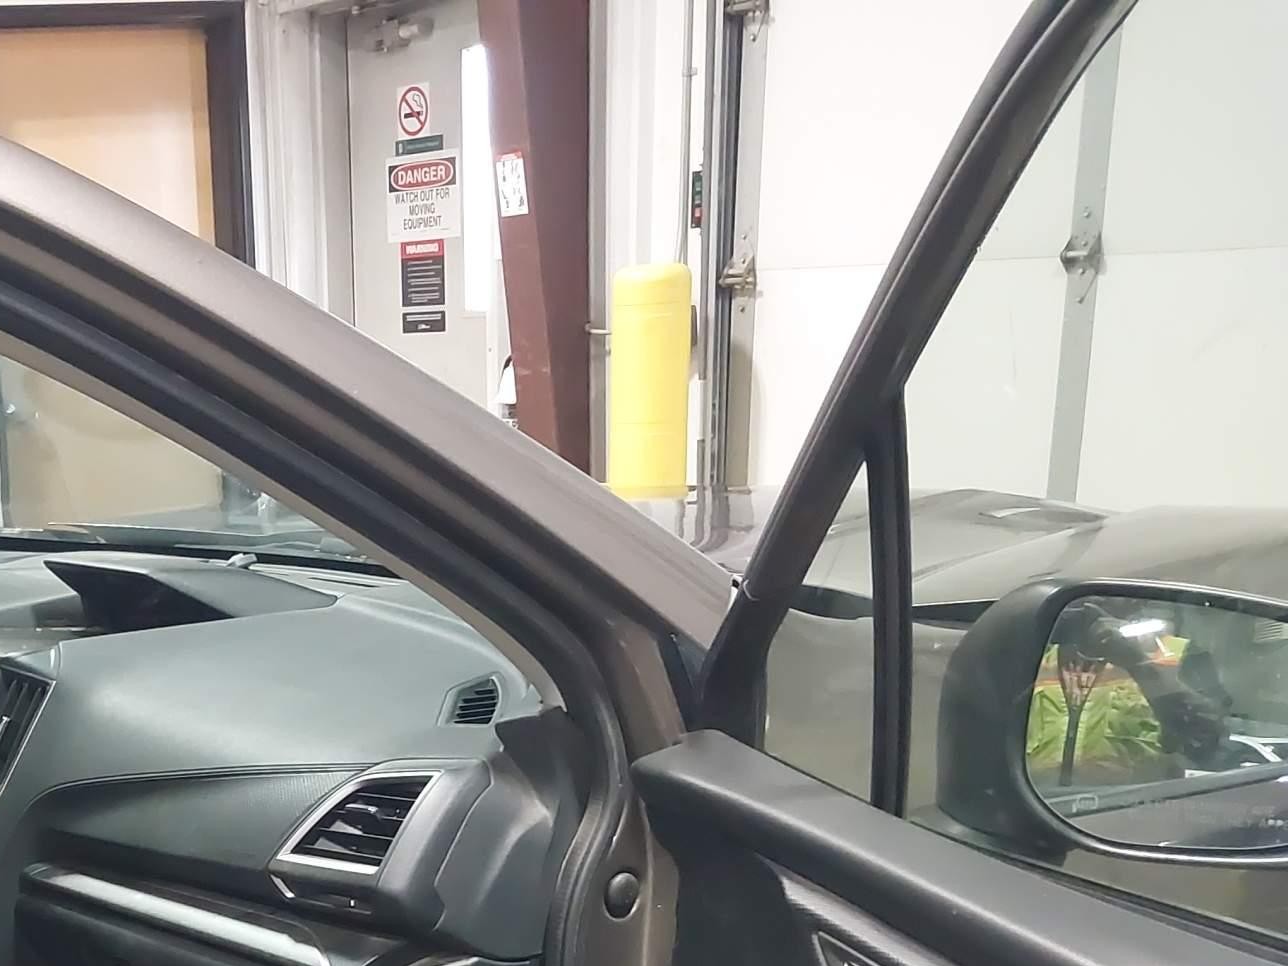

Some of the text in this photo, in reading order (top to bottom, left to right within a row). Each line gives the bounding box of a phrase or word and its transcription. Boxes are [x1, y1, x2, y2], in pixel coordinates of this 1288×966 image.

[397, 165, 446, 185] DANGER
[394, 187, 450, 204] WATCH OUT FOR
[408, 202, 436, 216] MOVING
[403, 215, 442, 231] EQUIPMENT
